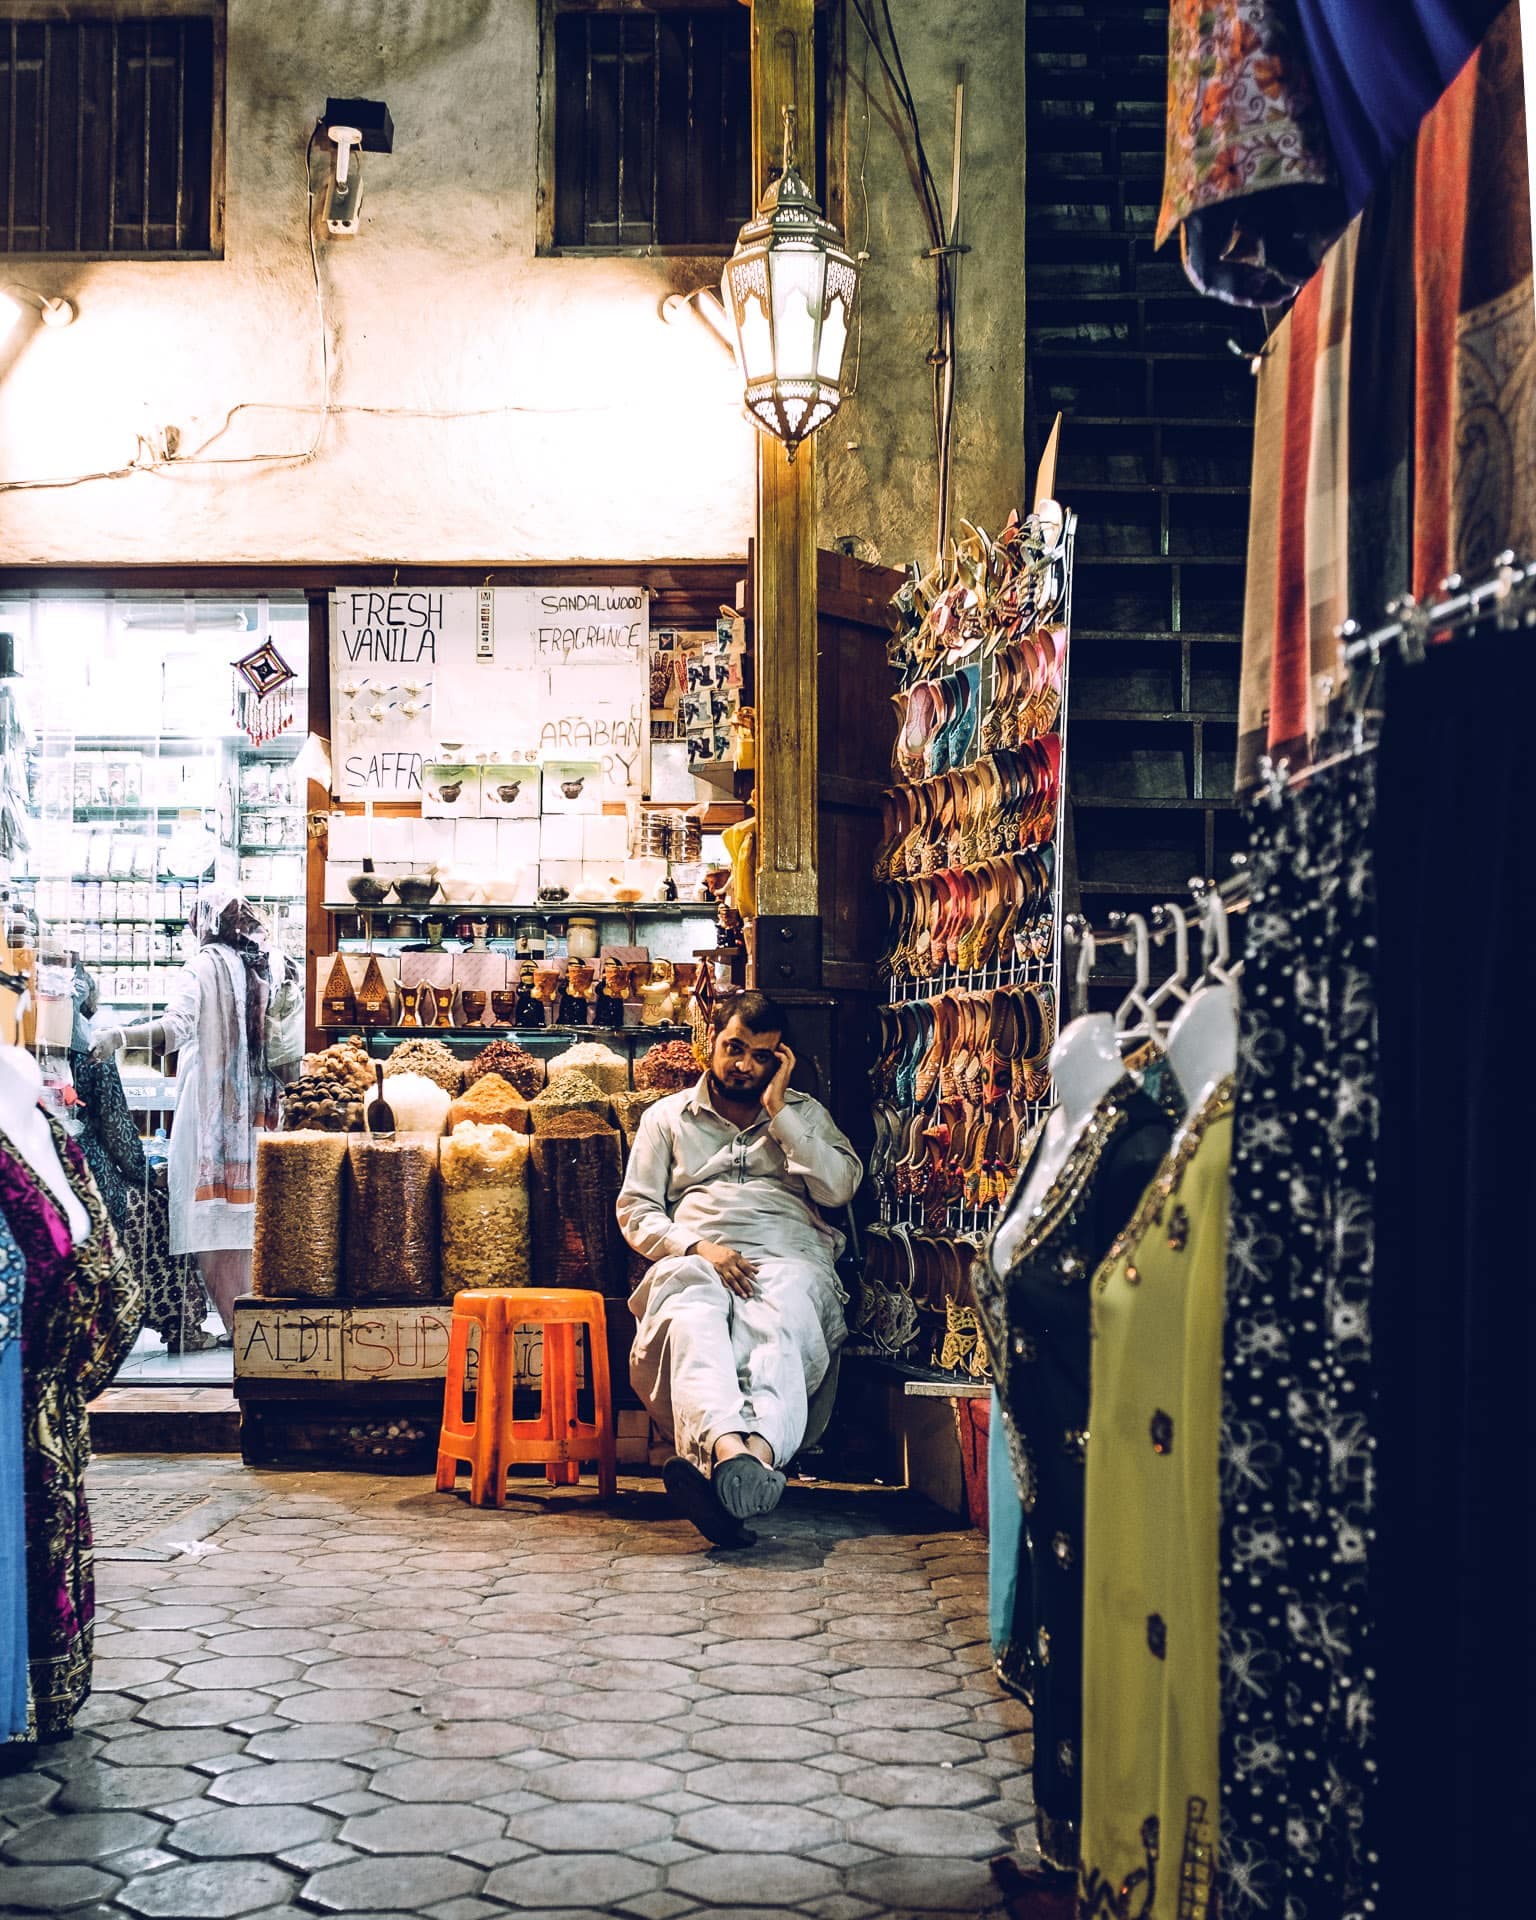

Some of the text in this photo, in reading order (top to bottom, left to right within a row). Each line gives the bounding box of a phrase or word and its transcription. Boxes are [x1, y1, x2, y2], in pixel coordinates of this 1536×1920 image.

[350, 592, 443, 630] FRESH
[341, 627, 436, 664] VANILA
[538, 622, 642, 652] FRAGRANCE
[539, 719, 642, 749] ARABIAN
[345, 752, 438, 790] SAFFR
[243, 1315, 334, 1362] ALDI
[352, 1315, 450, 1372] SUD
